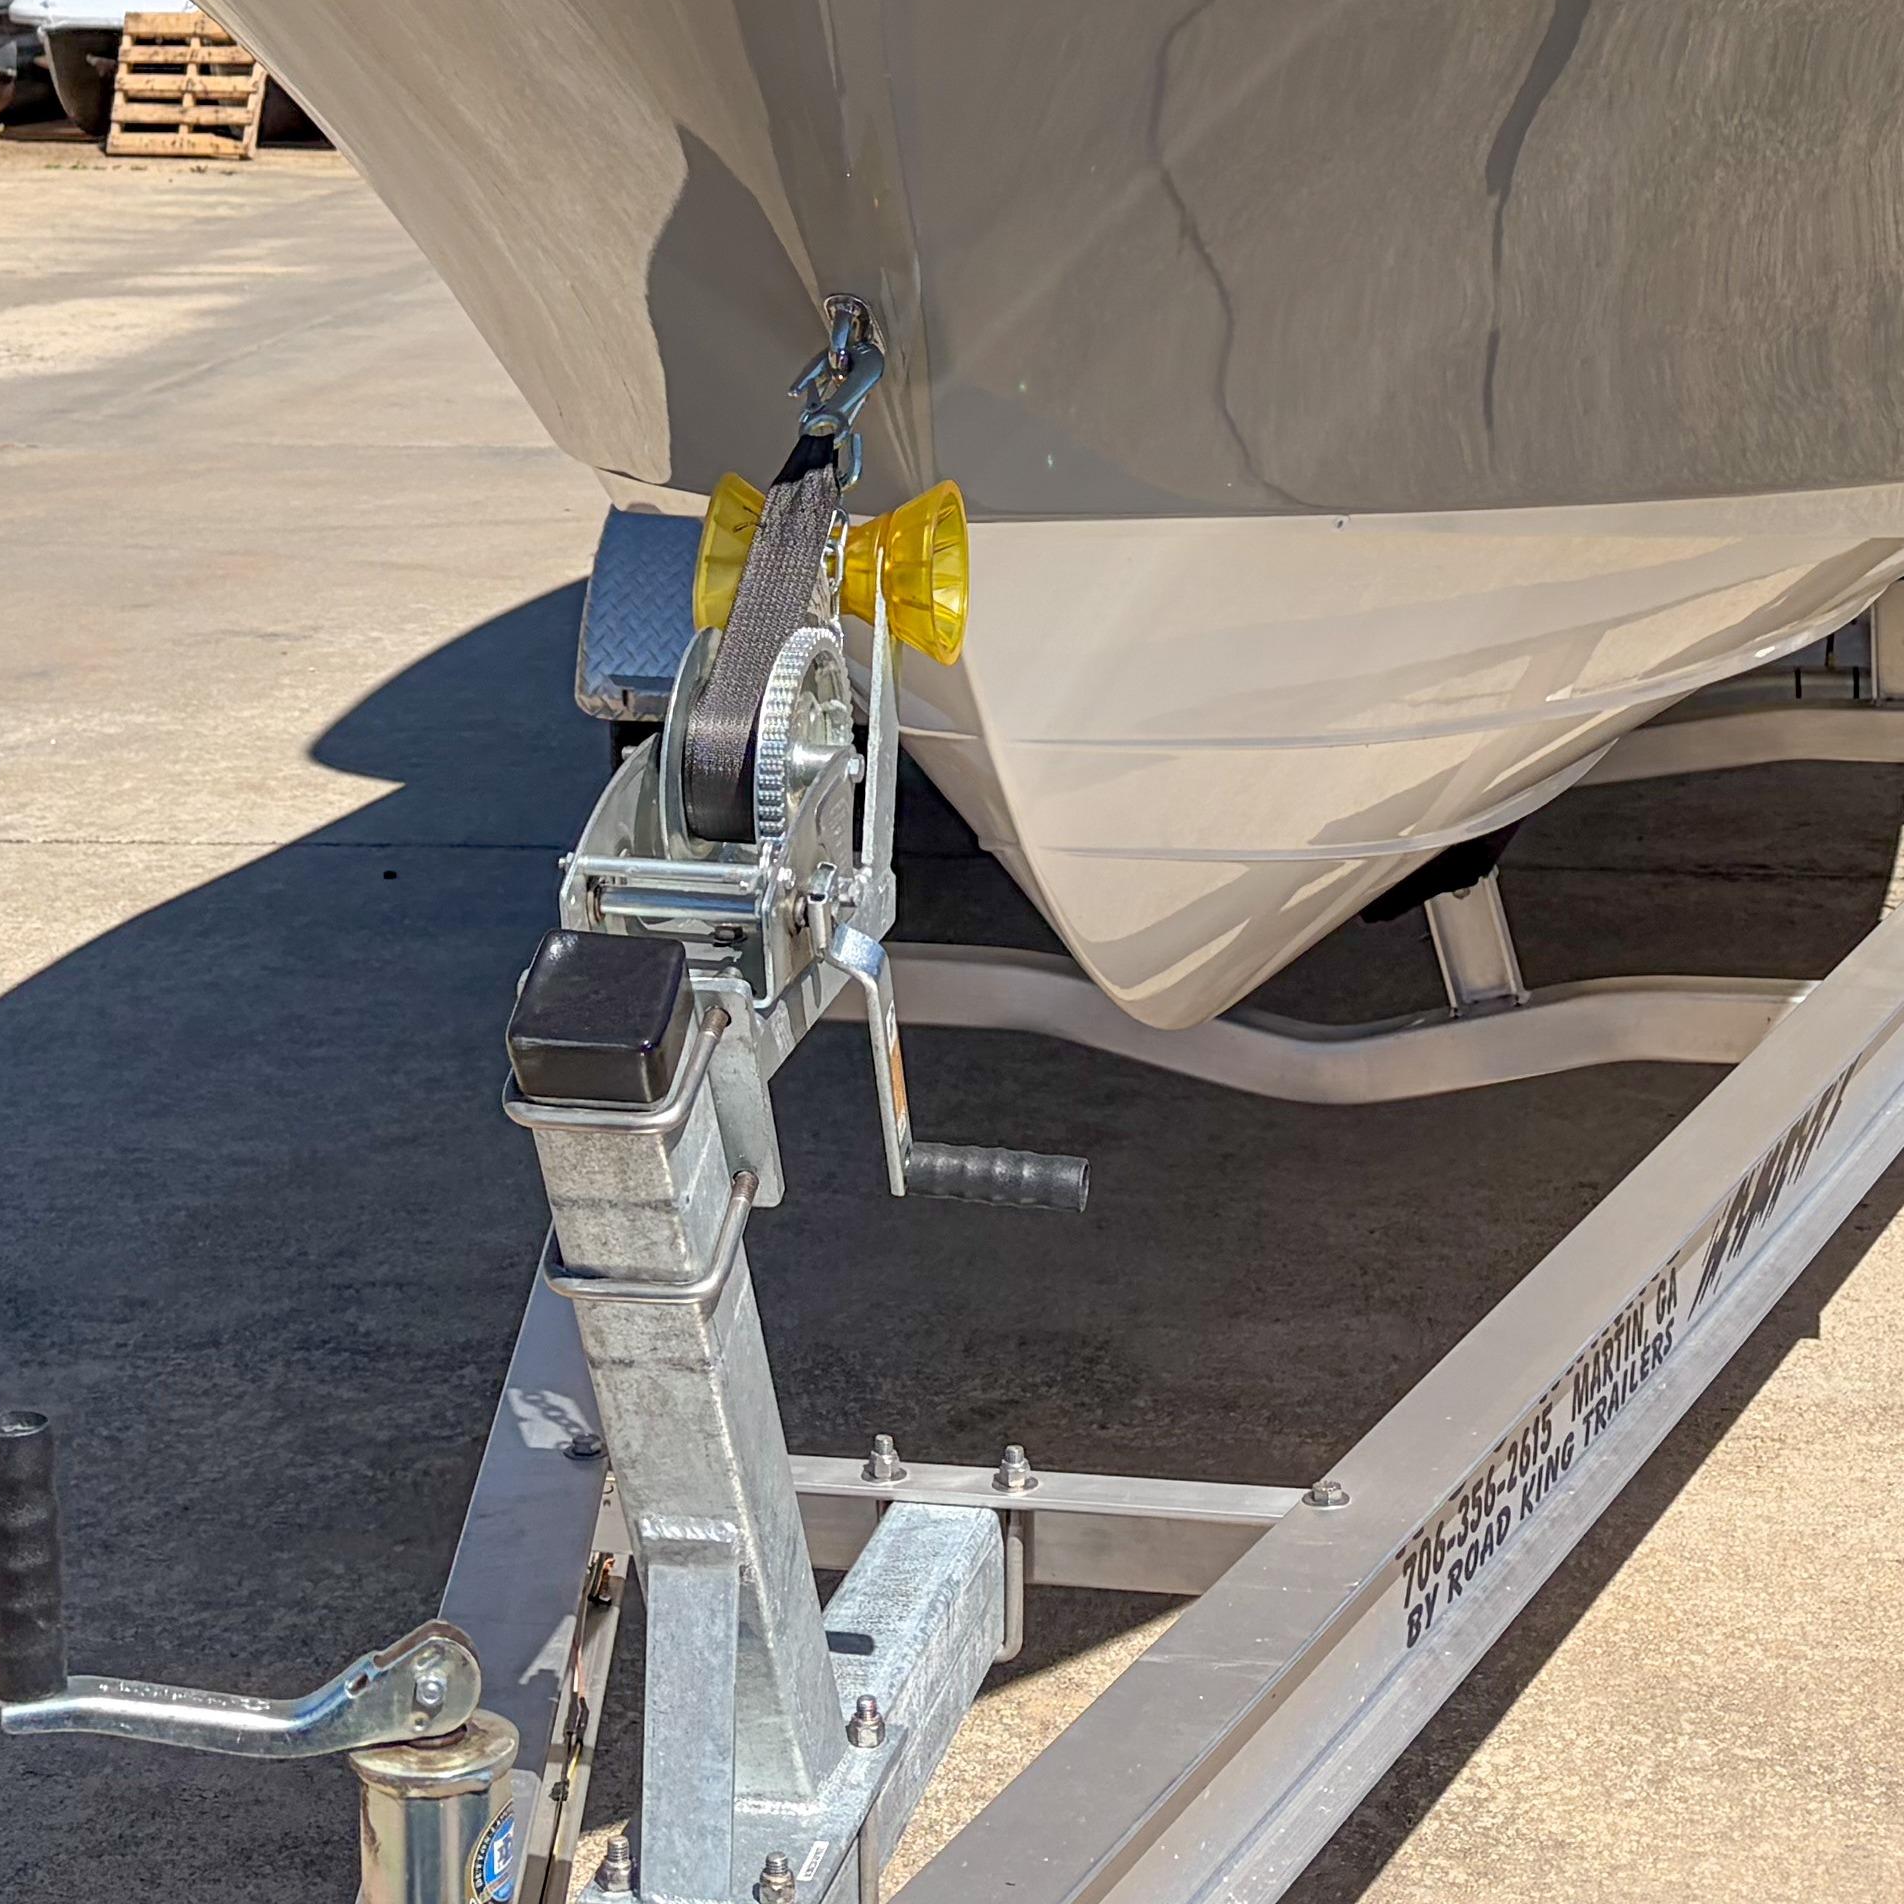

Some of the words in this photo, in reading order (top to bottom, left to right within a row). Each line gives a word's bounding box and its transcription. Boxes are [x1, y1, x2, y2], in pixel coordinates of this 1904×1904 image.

[1402, 1401, 1553, 1609] 706-356-2615
[1571, 1301, 1649, 1422] MARTIN,
[1656, 1267, 1678, 1325] GA
[1407, 1582, 1440, 1648] BY
[1447, 1505, 1511, 1604] ROAD
[1520, 1431, 1575, 1521] KING
[1582, 1316, 1675, 1448] TRAILERS
